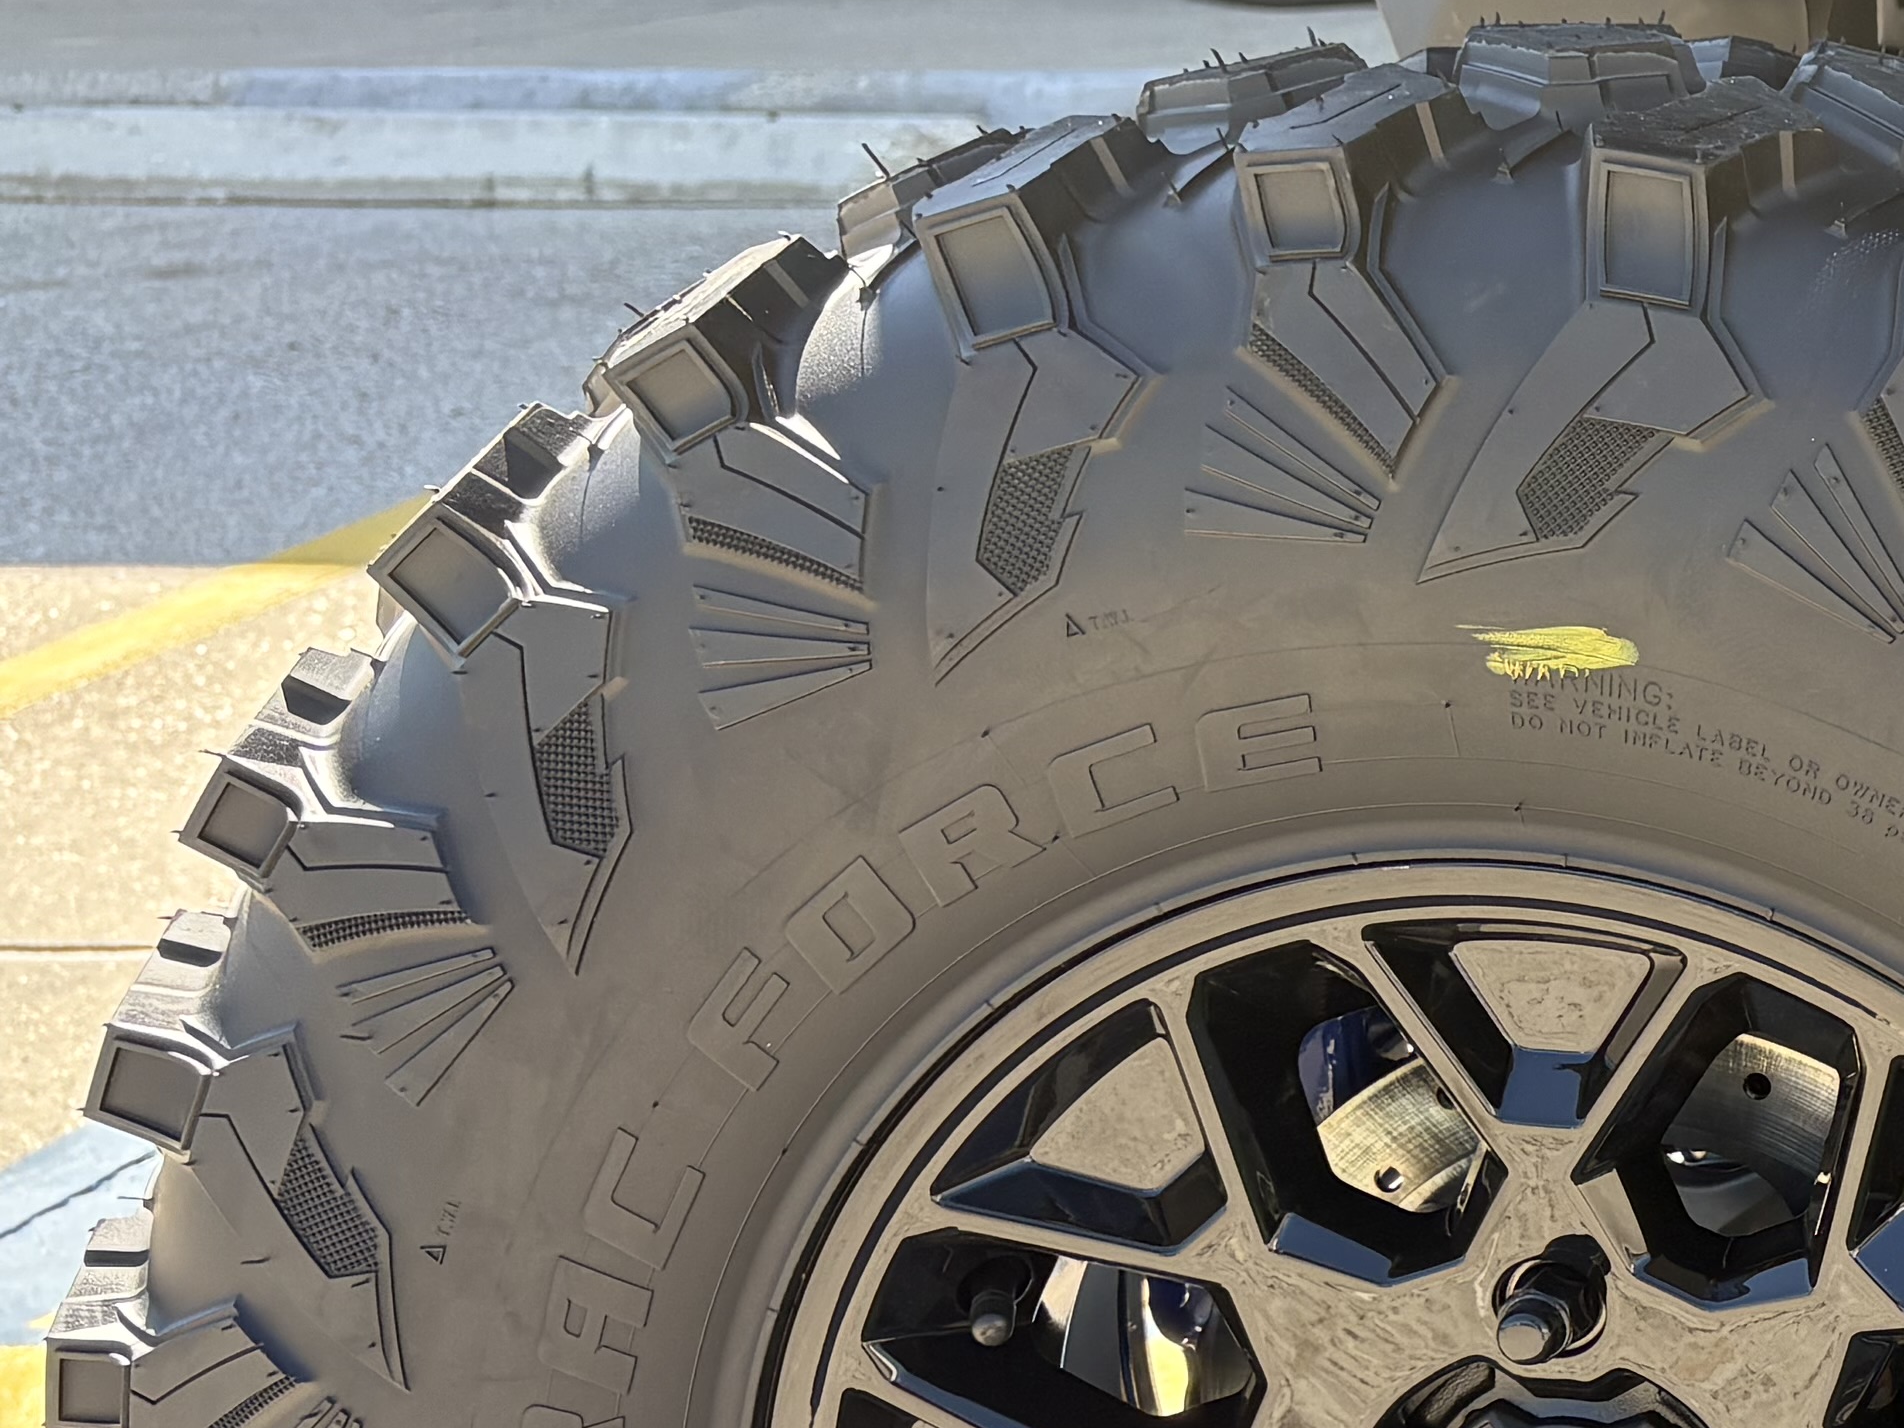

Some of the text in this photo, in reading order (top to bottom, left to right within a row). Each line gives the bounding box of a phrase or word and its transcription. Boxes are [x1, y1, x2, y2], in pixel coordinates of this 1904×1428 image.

[1509, 690, 1555, 711] SEE
[1573, 699, 1680, 734] VEHICLE
[1696, 724, 1770, 762] LABEL
[1789, 754, 1820, 779] OR
[1511, 712, 1544, 731] DO
[1560, 718, 1607, 739] NOT
[1624, 729, 1723, 767] INFLATE
[1739, 758, 1831, 805] BEYOND
[687, 691, 1323, 1090] FORCE
